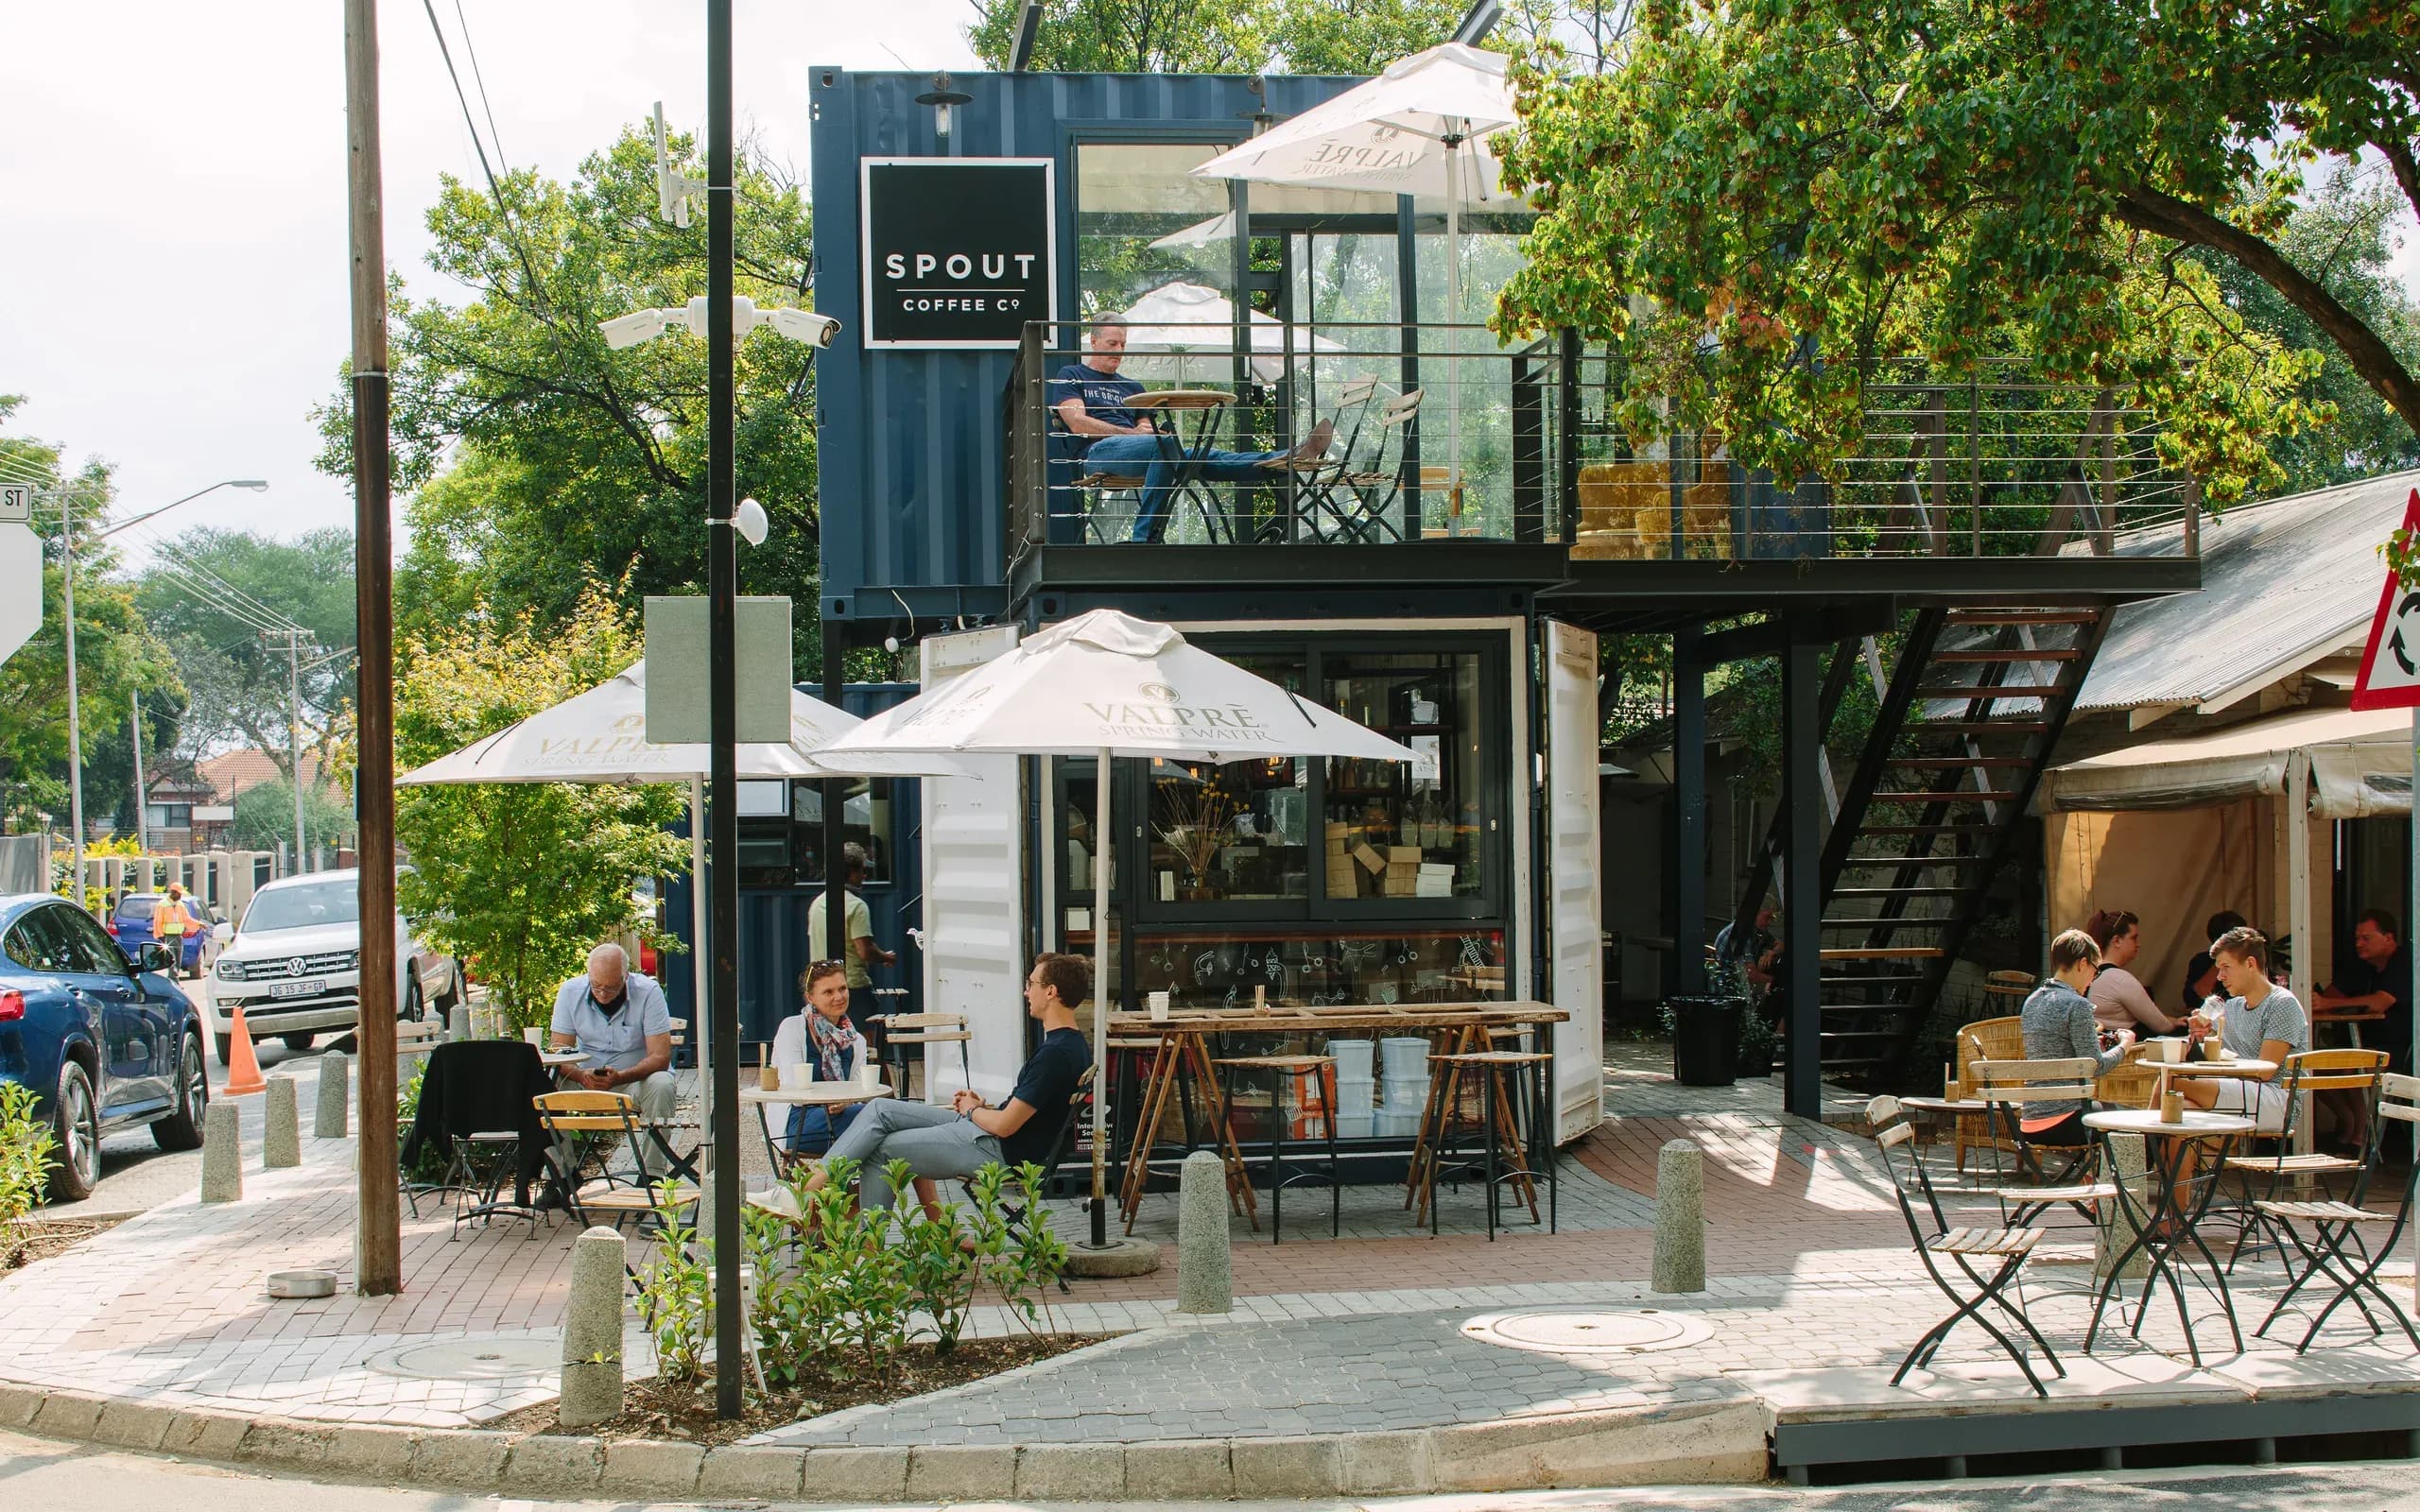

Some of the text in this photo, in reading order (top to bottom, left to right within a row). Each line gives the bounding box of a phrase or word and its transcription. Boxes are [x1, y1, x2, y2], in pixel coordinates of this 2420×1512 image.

[886, 253, 1036, 280] SPOUT
[903, 299, 986, 312] COFFEE
[1083, 388, 1099, 399] THE
[5, 490, 24, 507] ST
[1098, 724, 1287, 744] SPRING WATER
